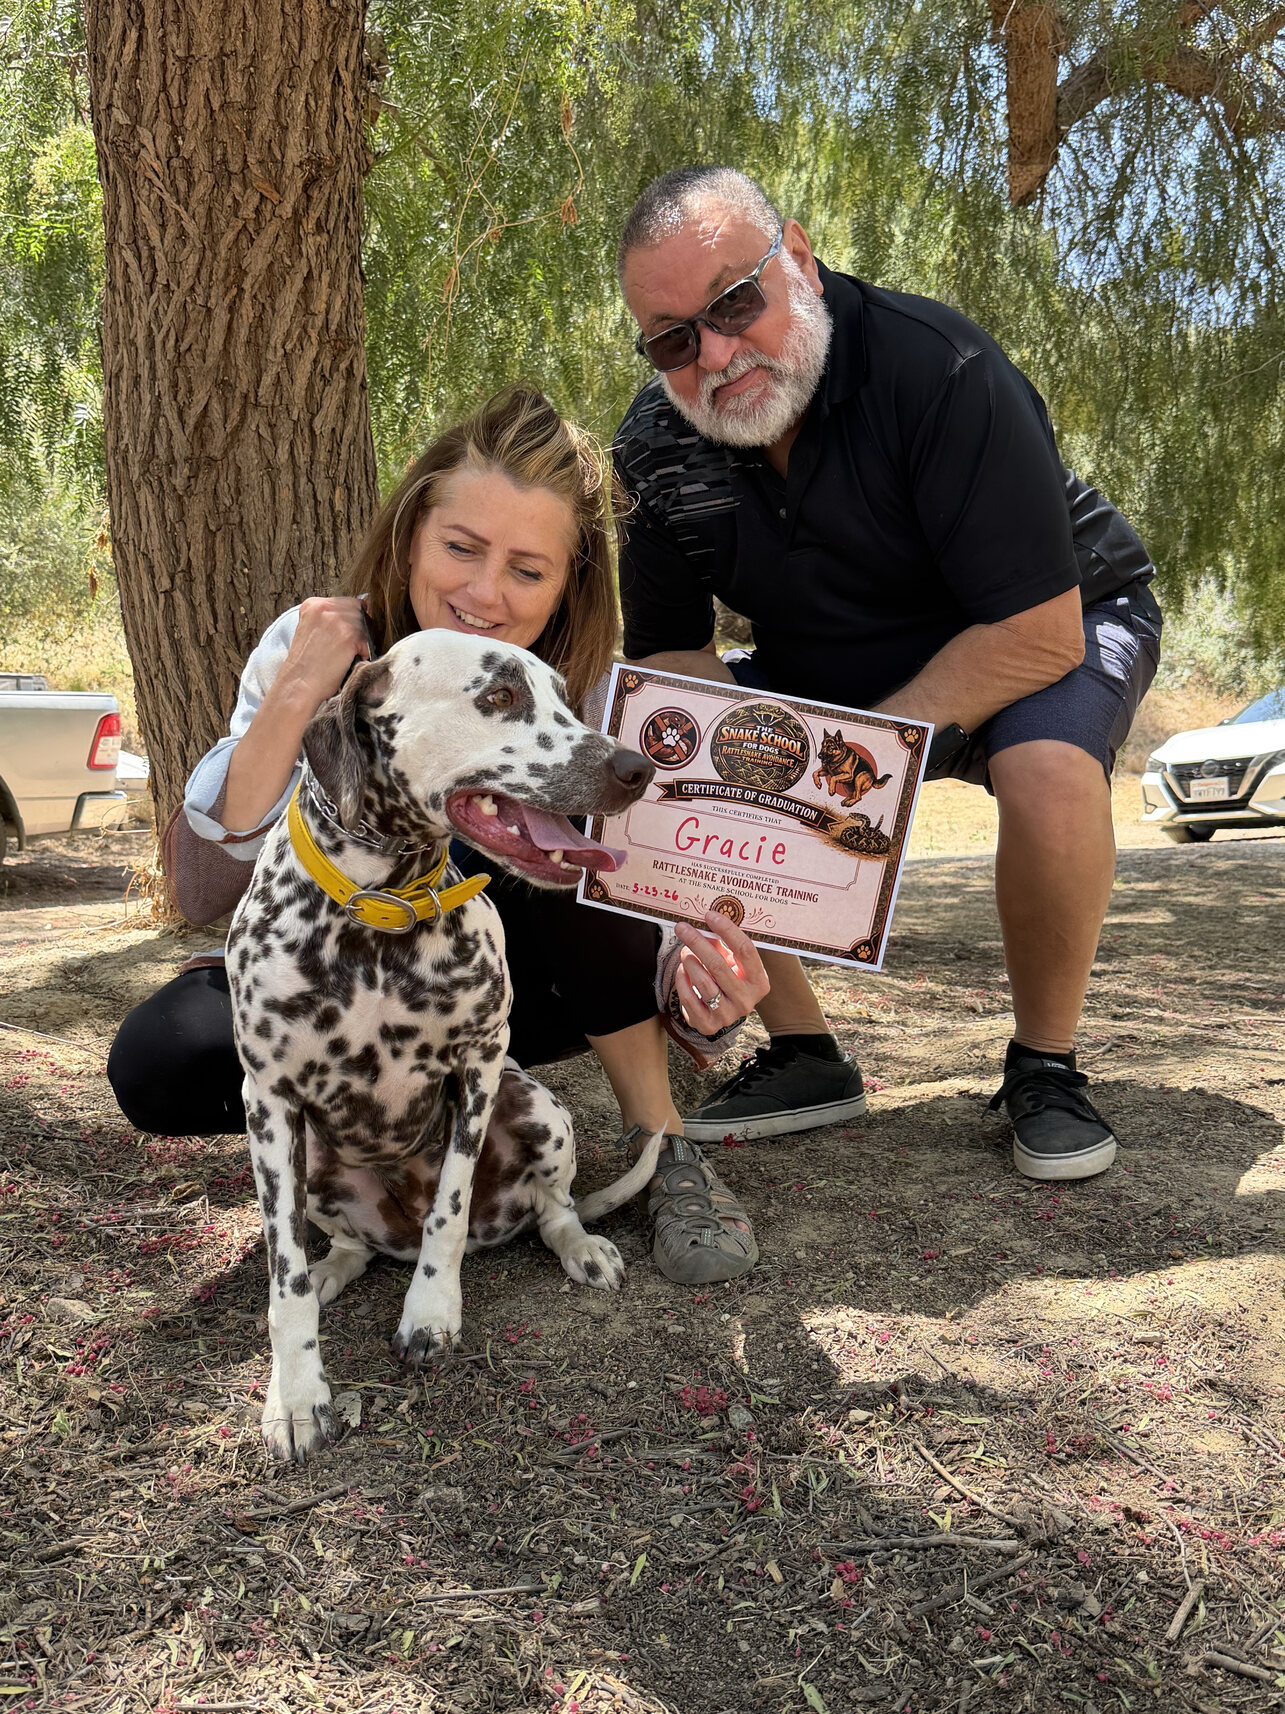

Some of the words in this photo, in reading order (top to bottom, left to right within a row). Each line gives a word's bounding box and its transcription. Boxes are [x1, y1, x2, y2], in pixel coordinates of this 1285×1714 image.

[720, 726, 759, 741] SNAKE
[760, 732, 803, 757] SCHOOL
[743, 742, 757, 750] FOR
[758, 744, 779, 755] DOGS
[721, 745, 761, 759] RATTLESNAKE
[762, 752, 795, 768] AVOIDANCE
[742, 756, 773, 767] TRAINING
[682, 783, 742, 799] CERTIFICATE
[744, 790, 757, 801] OF
[758, 793, 818, 821] GRADUATION
[712, 805, 728, 814] THIS
[728, 808, 763, 822] CERTIFIES
[764, 816, 782, 825] THAT
[675, 816, 786, 865] Gracie
[652, 859, 718, 882] RATTLESNAKE
[720, 875, 773, 894] AVOIDANCE
[776, 886, 819, 903] TRAINING
[703, 864, 745, 877] SUCCESSFULLY
[745, 873, 780, 884] COMPLETED
[688, 879, 702, 887] THE
[703, 882, 725, 892] SNAKE
[726, 888, 754, 898] SCHOOL
[755, 893, 769, 901] FOR
[770, 896, 788, 905] DOGS
